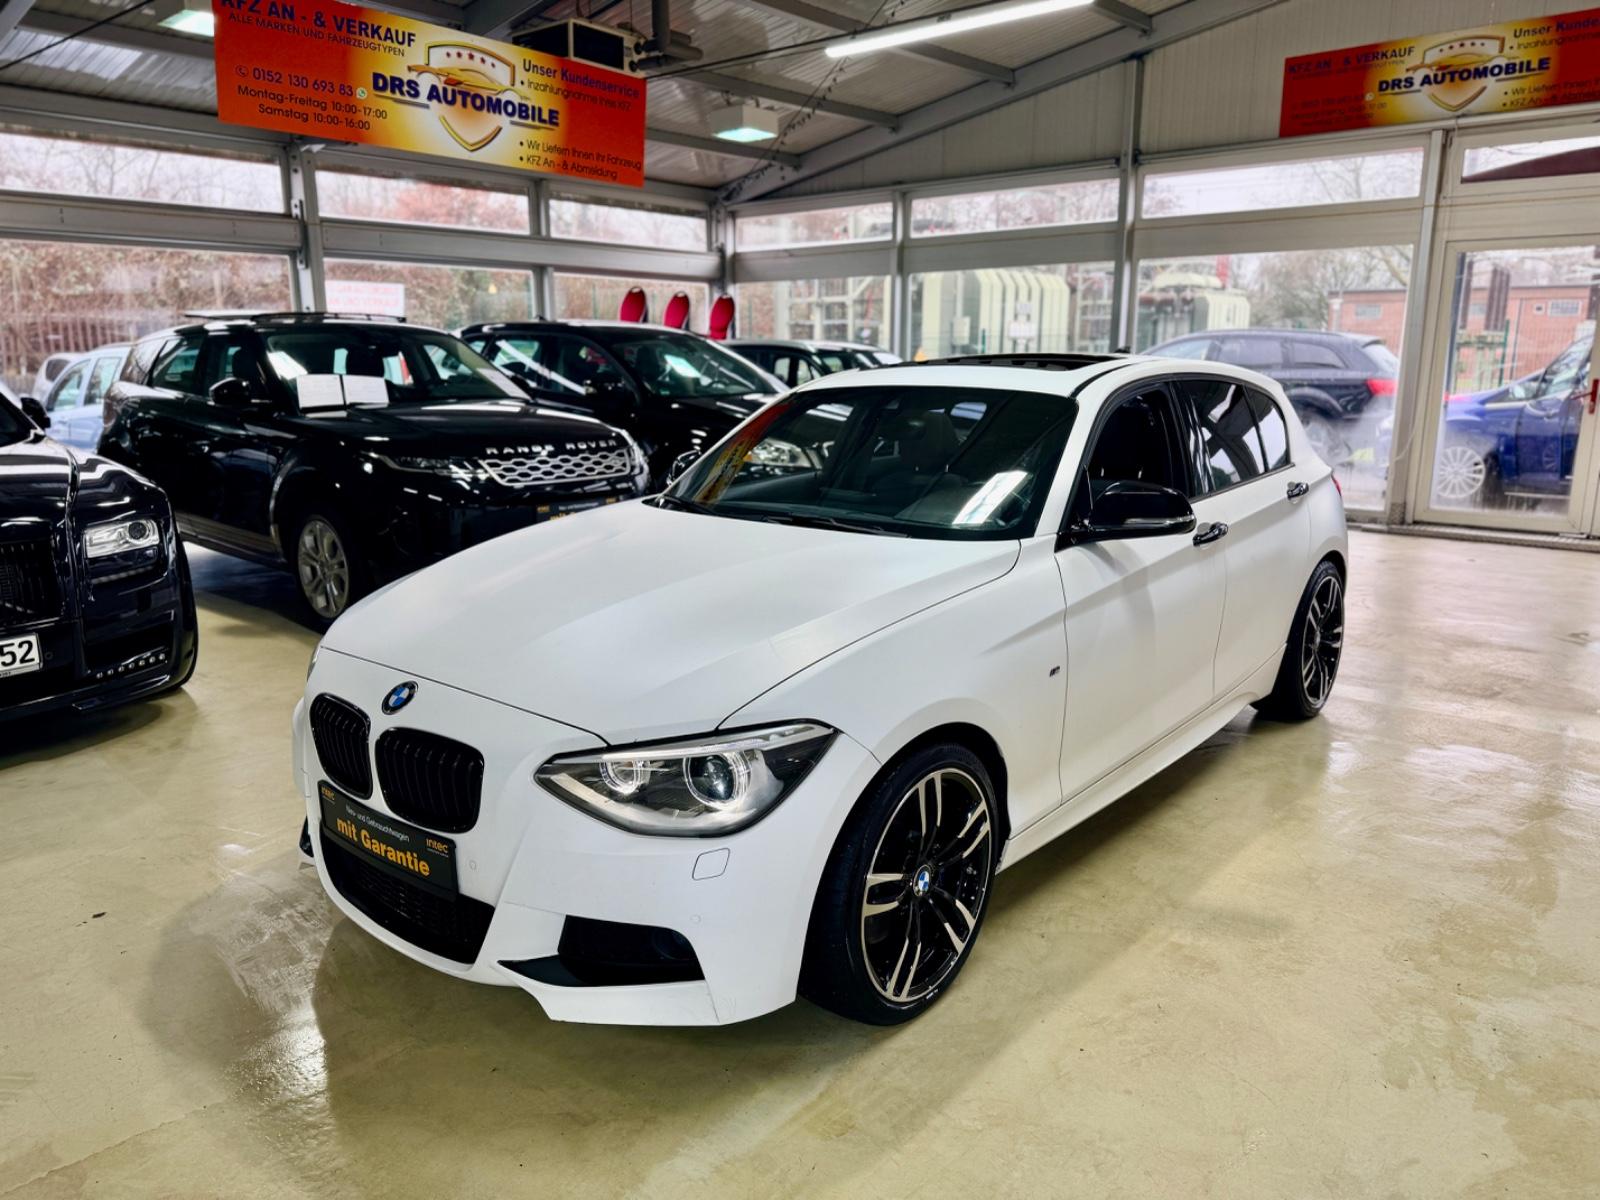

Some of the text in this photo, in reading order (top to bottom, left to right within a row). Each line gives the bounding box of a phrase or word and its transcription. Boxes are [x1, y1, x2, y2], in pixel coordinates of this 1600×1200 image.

[228, 13, 405, 57] ALLE MARKEN UND FAHRZEUGTYPEN
[268, 2, 295, 20] AN
[313, 11, 326, 28] &
[333, 15, 416, 47] VERKAUF
[1513, 24, 1552, 38] Unser
[1356, 46, 1415, 65] VERKAUF
[252, 68, 354, 97] 0152 130 693 83
[522, 58, 639, 98] Unser Kundenservice
[1378, 76, 1415, 93] DRS
[1420, 57, 1552, 86] AUTOMOBILE
[237, 85, 388, 120] Montag-Freitag 10:00-17:00
[371, 72, 560, 127] DRS AUTOMOBILE
[258, 103, 371, 131] Samstag 10:00-16:00
[526, 140, 540, 151] Wir
[526, 155, 541, 166] KFZ
[543, 157, 555, 168] An
[486, 439, 617, 455] RANGE ROVER
[0, 640, 35, 667] 52
[336, 817, 430, 877] mit Garantie
[426, 838, 449, 853] intec
